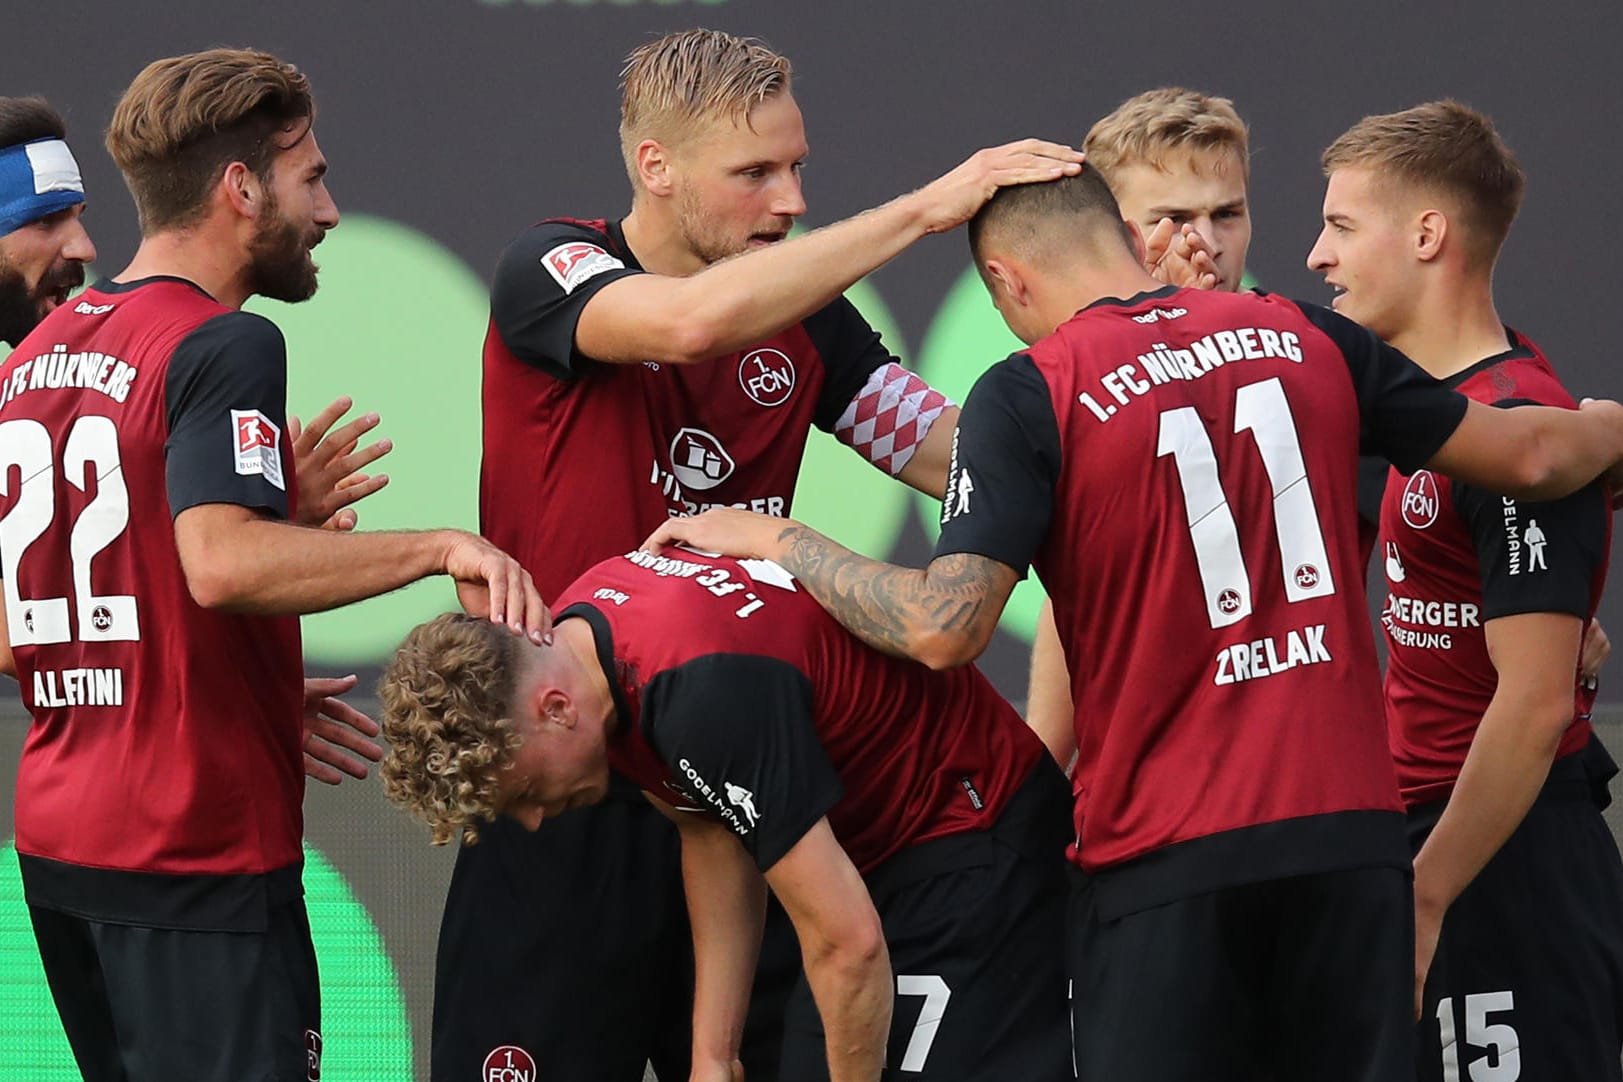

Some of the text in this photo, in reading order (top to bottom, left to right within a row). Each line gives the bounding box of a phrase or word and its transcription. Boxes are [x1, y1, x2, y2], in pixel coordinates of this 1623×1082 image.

[748, 368, 791, 398] FCN
[1078, 327, 1304, 423] 1. FC NÜRNBERG
[0, 414, 140, 648] 22
[1157, 377, 1335, 629] 11
[1404, 491, 1433, 518] FCN
[695, 568, 746, 597] FC
[1214, 624, 1332, 687] ZRELAK
[1436, 990, 1521, 1082] 15
